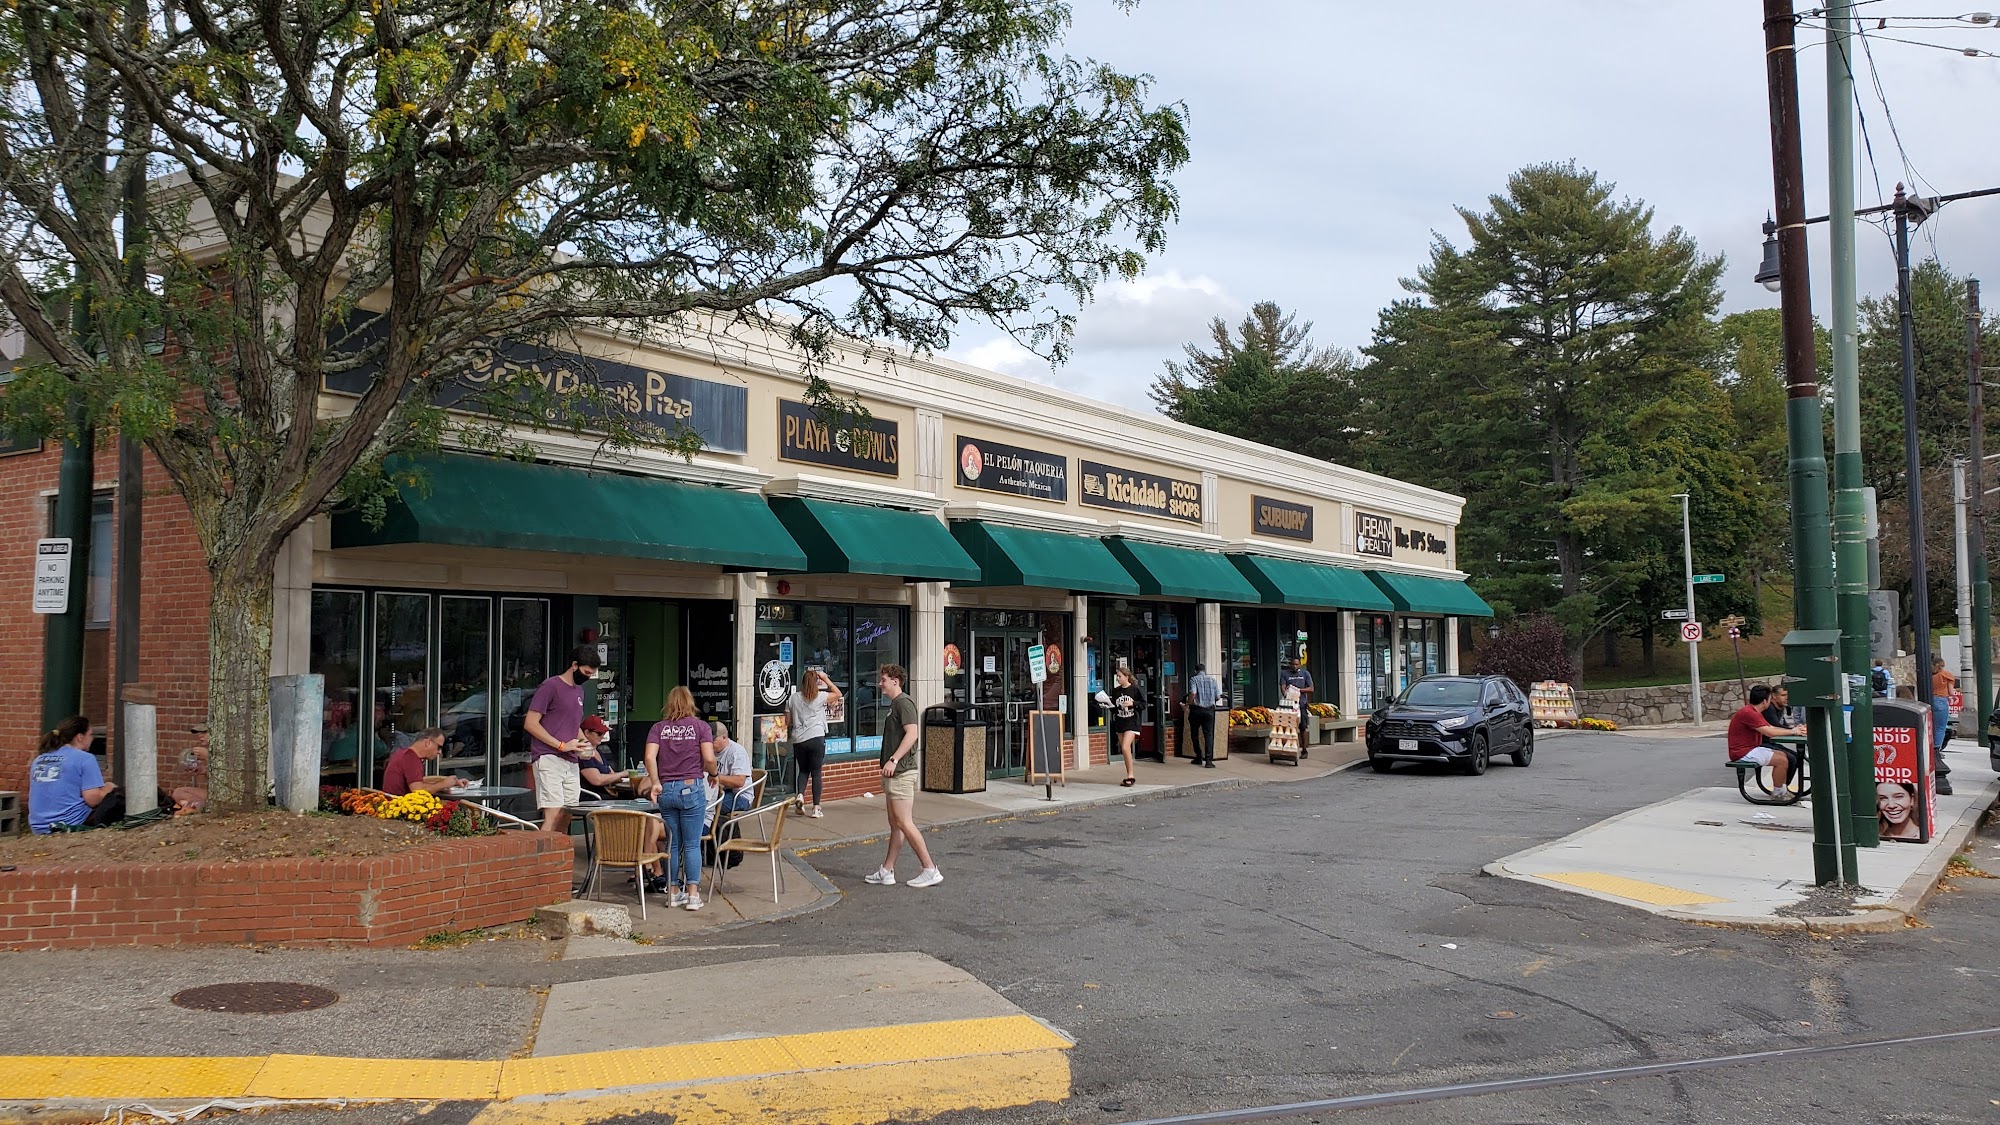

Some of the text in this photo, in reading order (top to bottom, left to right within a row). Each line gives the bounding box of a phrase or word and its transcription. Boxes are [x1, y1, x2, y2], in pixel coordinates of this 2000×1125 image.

[646, 371, 693, 420] Pizza
[785, 415, 831, 453] PLAYA
[984, 452, 995, 467] EL
[997, 454, 1022, 472] PELÓN
[1023, 460, 1065, 480] TAQUERIA
[999, 474, 1051, 492] Authentic Mexican
[1106, 472, 1167, 509] Richdale
[1171, 481, 1198, 501] FOOD
[1169, 499, 1200, 519] SHOPS
[1258, 504, 1308, 532] SUBWAY
[1357, 515, 1391, 540] URBAN
[1364, 536, 1392, 554] REALTY
[1394, 526, 1447, 555] The UPS Store
[758, 604, 785, 620] 2199
[1873, 733, 1910, 743] NDID
[1874, 768, 1911, 777] NDID
